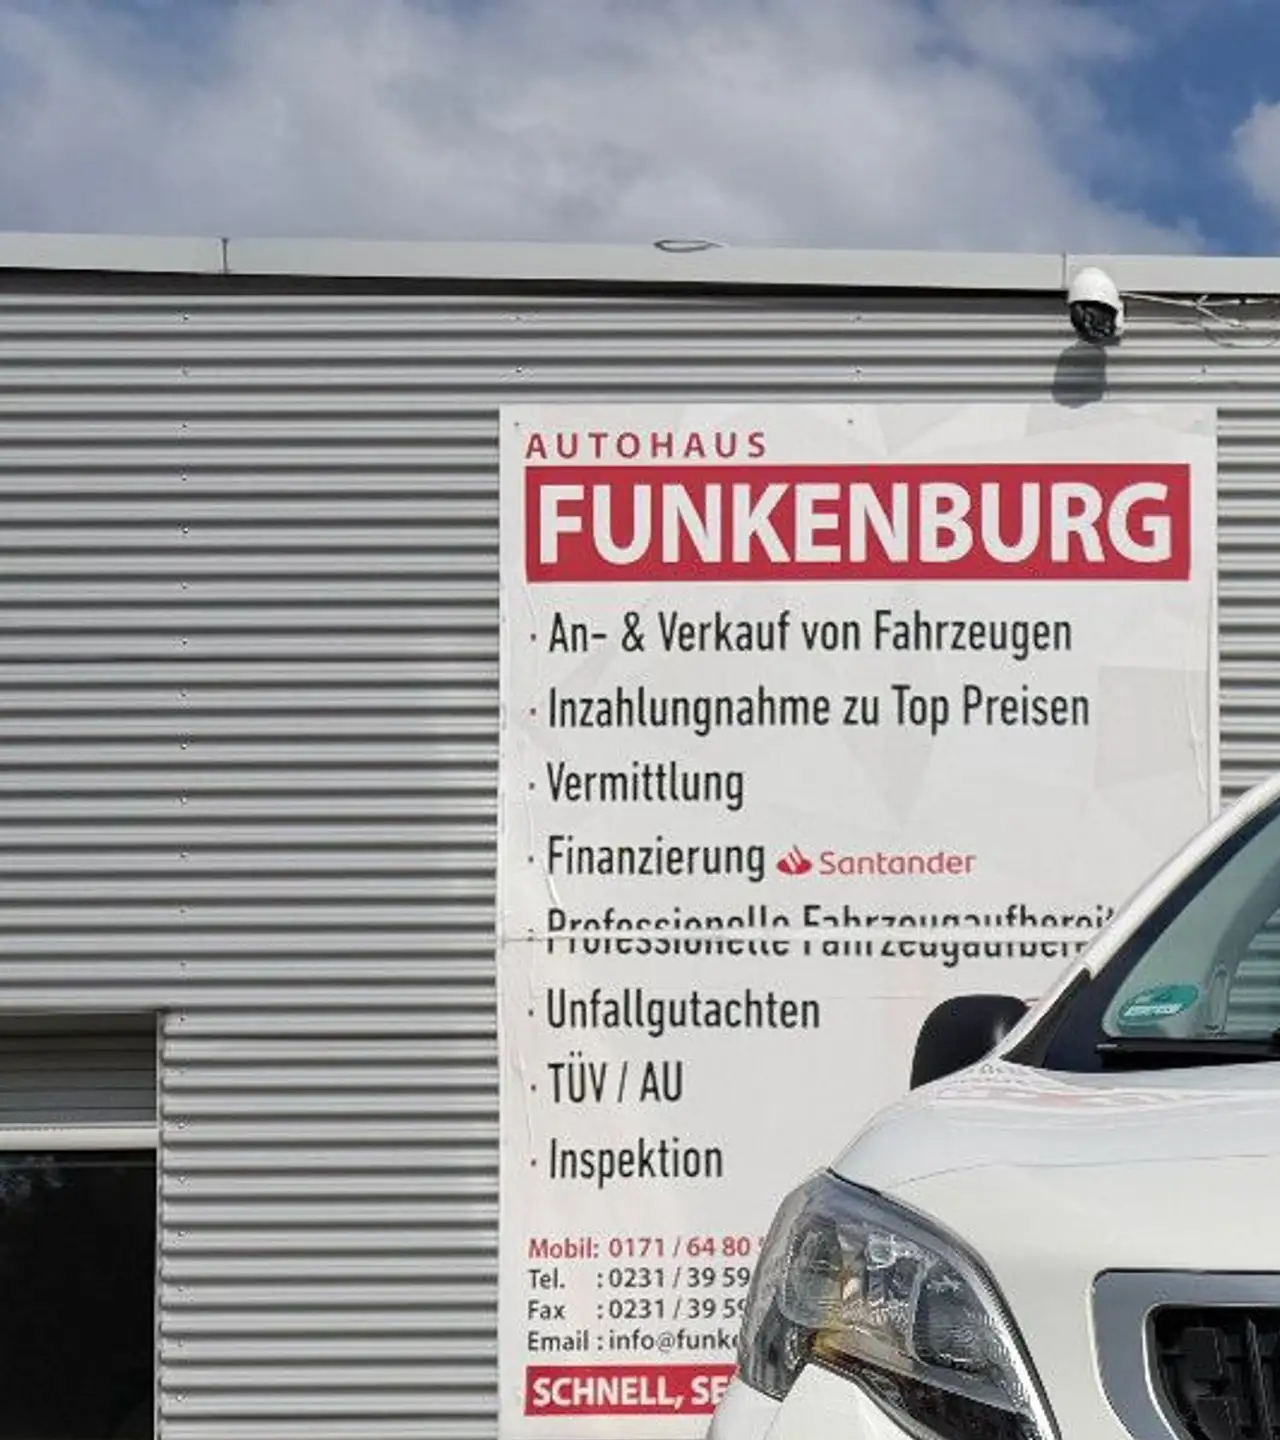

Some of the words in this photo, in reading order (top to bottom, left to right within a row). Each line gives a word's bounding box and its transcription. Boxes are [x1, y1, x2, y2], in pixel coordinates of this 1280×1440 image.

[525, 431, 765, 460] AUTOHAUS
[539, 481, 1172, 565] FUNKENBURG
[549, 611, 607, 653] An-
[621, 611, 645, 653] &
[658, 609, 790, 652] Verkauf
[801, 620, 860, 651] von
[875, 609, 1071, 661] Fahrzeugen
[549, 685, 830, 737] Inzahlungnahme
[842, 695, 879, 726] zu
[890, 684, 949, 736] Top
[963, 684, 1089, 726] Preisen
[547, 760, 744, 811] Vermittlung
[548, 834, 765, 882] Finanzierung
[819, 850, 976, 876] Santander
[547, 904, 790, 956] Professionelle
[547, 988, 820, 1037] Unfallgutachten
[548, 1052, 607, 1103] TÜV
[617, 1060, 629, 1104] /
[639, 1060, 683, 1102] AU
[550, 1136, 723, 1189] Inspektion
[528, 1236, 599, 1259] Mobil:
[608, 1237, 664, 1258] 0171
[672, 1236, 681, 1258] /
[686, 1236, 716, 1257] 64
[721, 1236, 751, 1257] 80
[527, 1268, 566, 1290] Tel.
[608, 1267, 664, 1288] 0231
[671, 1266, 682, 1289] /
[687, 1266, 716, 1288] 39
[723, 1266, 750, 1288] 59
[528, 1299, 565, 1321] Fax
[608, 1298, 664, 1320] 0231
[672, 1297, 683, 1321] /
[687, 1297, 716, 1319] 39
[527, 1330, 589, 1352] Email
[532, 1374, 685, 1410] SCHNELL,
